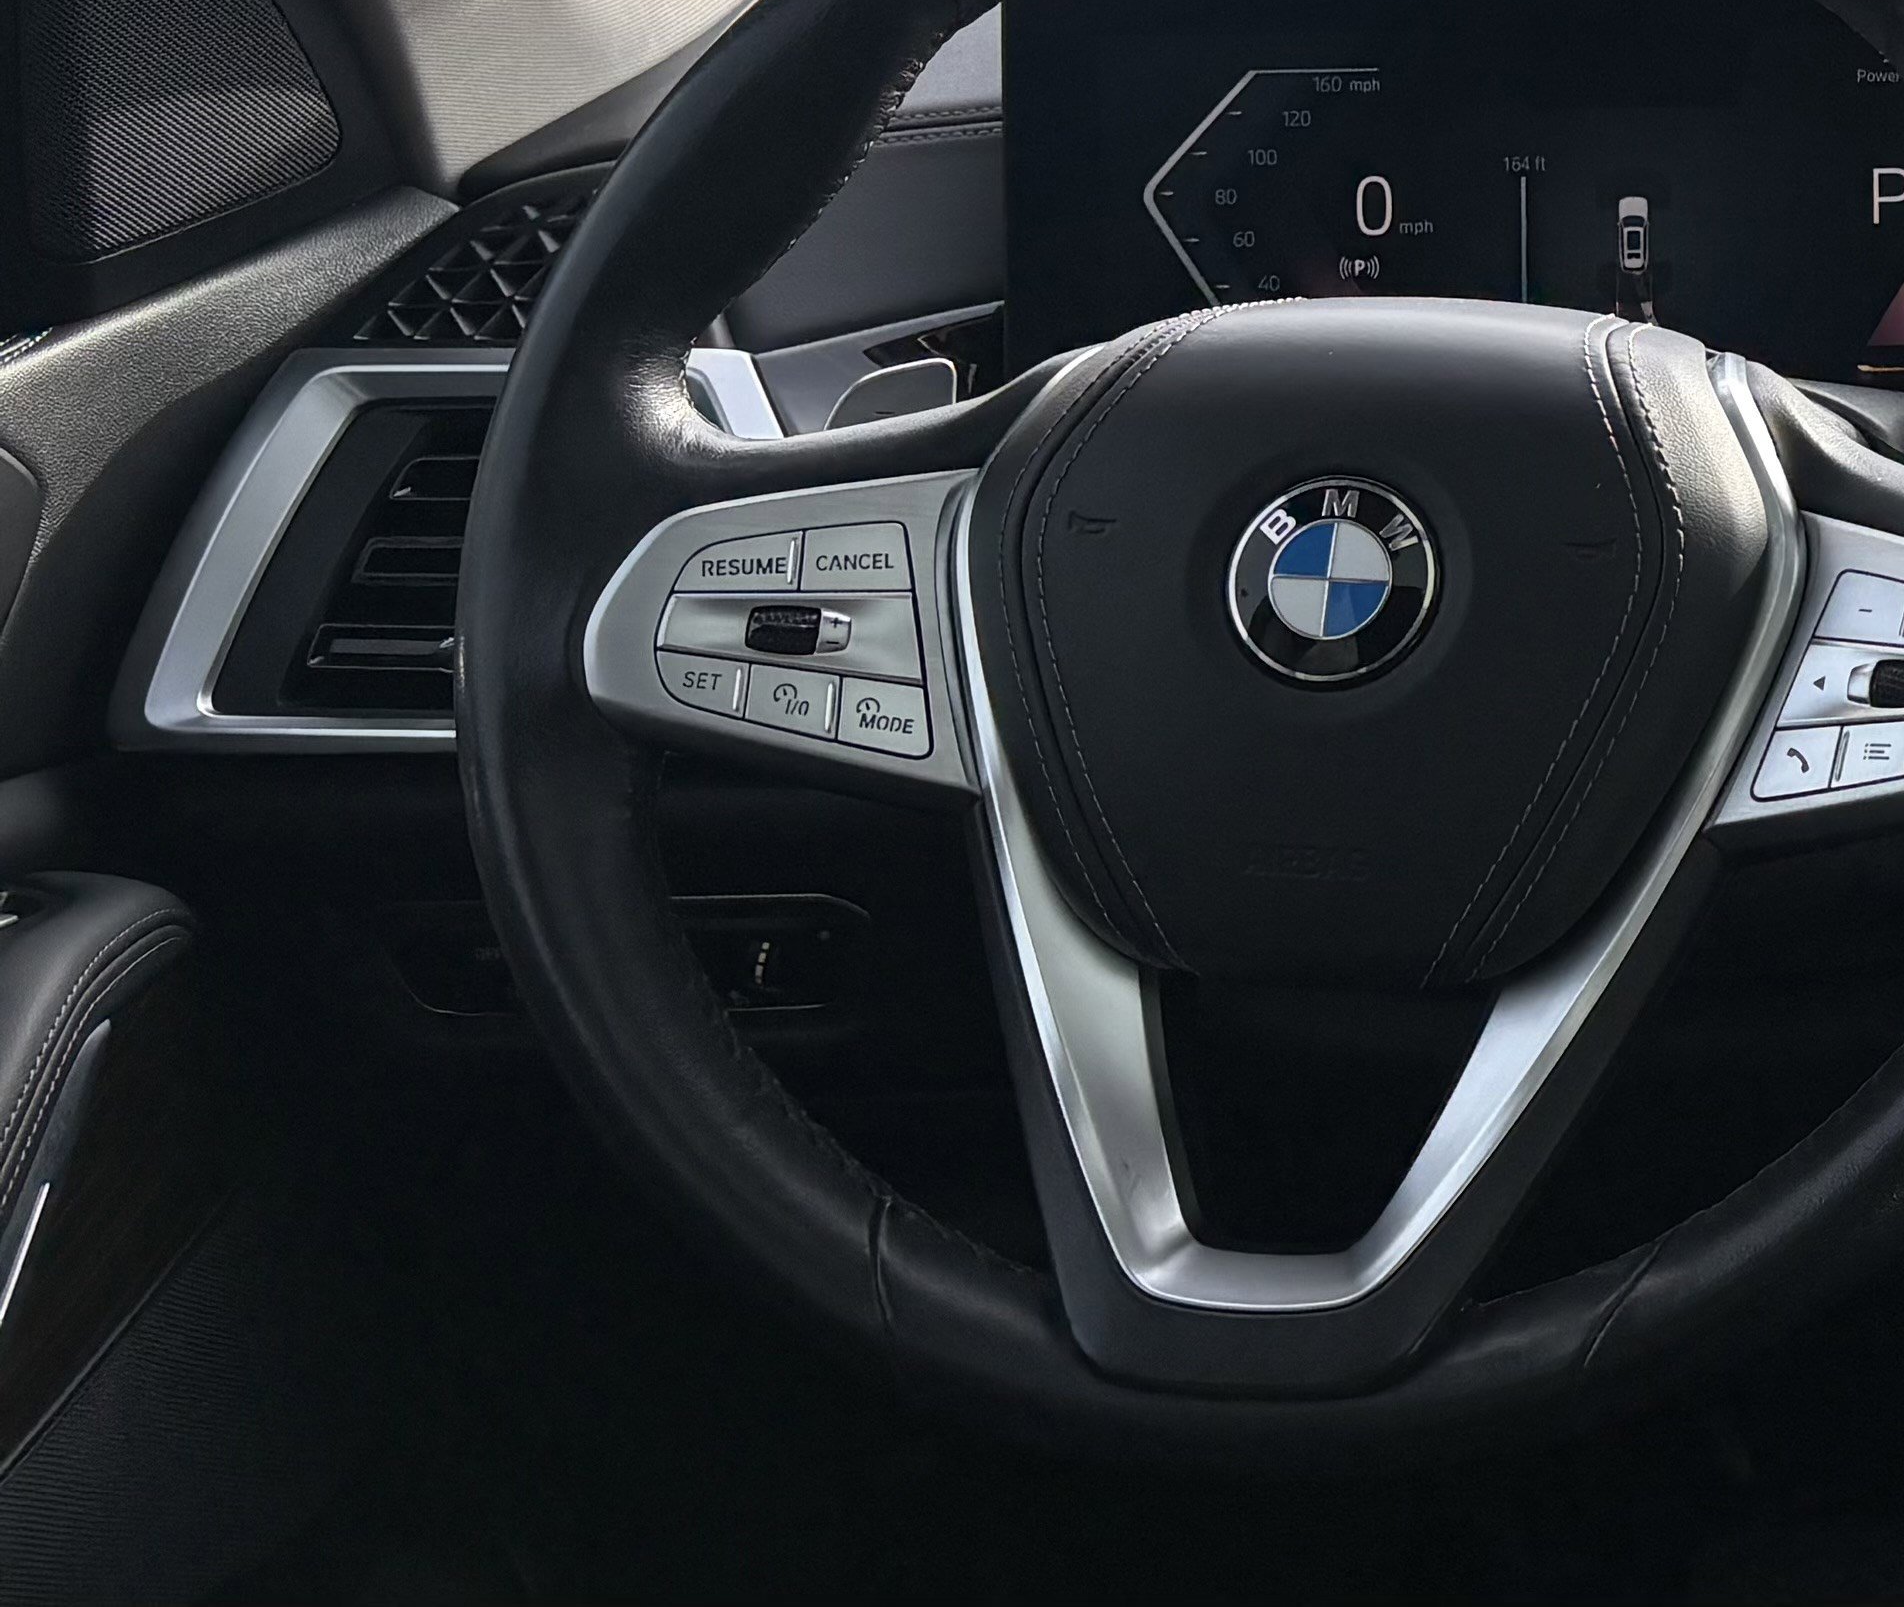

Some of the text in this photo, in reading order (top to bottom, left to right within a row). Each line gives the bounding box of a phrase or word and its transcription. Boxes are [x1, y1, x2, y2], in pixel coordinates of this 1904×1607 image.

[1314, 76, 1381, 94] 160 mph
[1282, 111, 1312, 127] 120
[1247, 149, 1278, 165] 100
[1535, 156, 1546, 171] ft
[1214, 189, 1237, 205] 80
[1355, 175, 1434, 237] 0 mph
[1232, 231, 1256, 247] 60
[1257, 276, 1281, 291] 40
[1259, 488, 1419, 552] BMW
[702, 557, 786, 577] RESUME
[816, 553, 894, 572] CANCEL
[682, 671, 722, 691] SET
[858, 712, 915, 735] MODE
